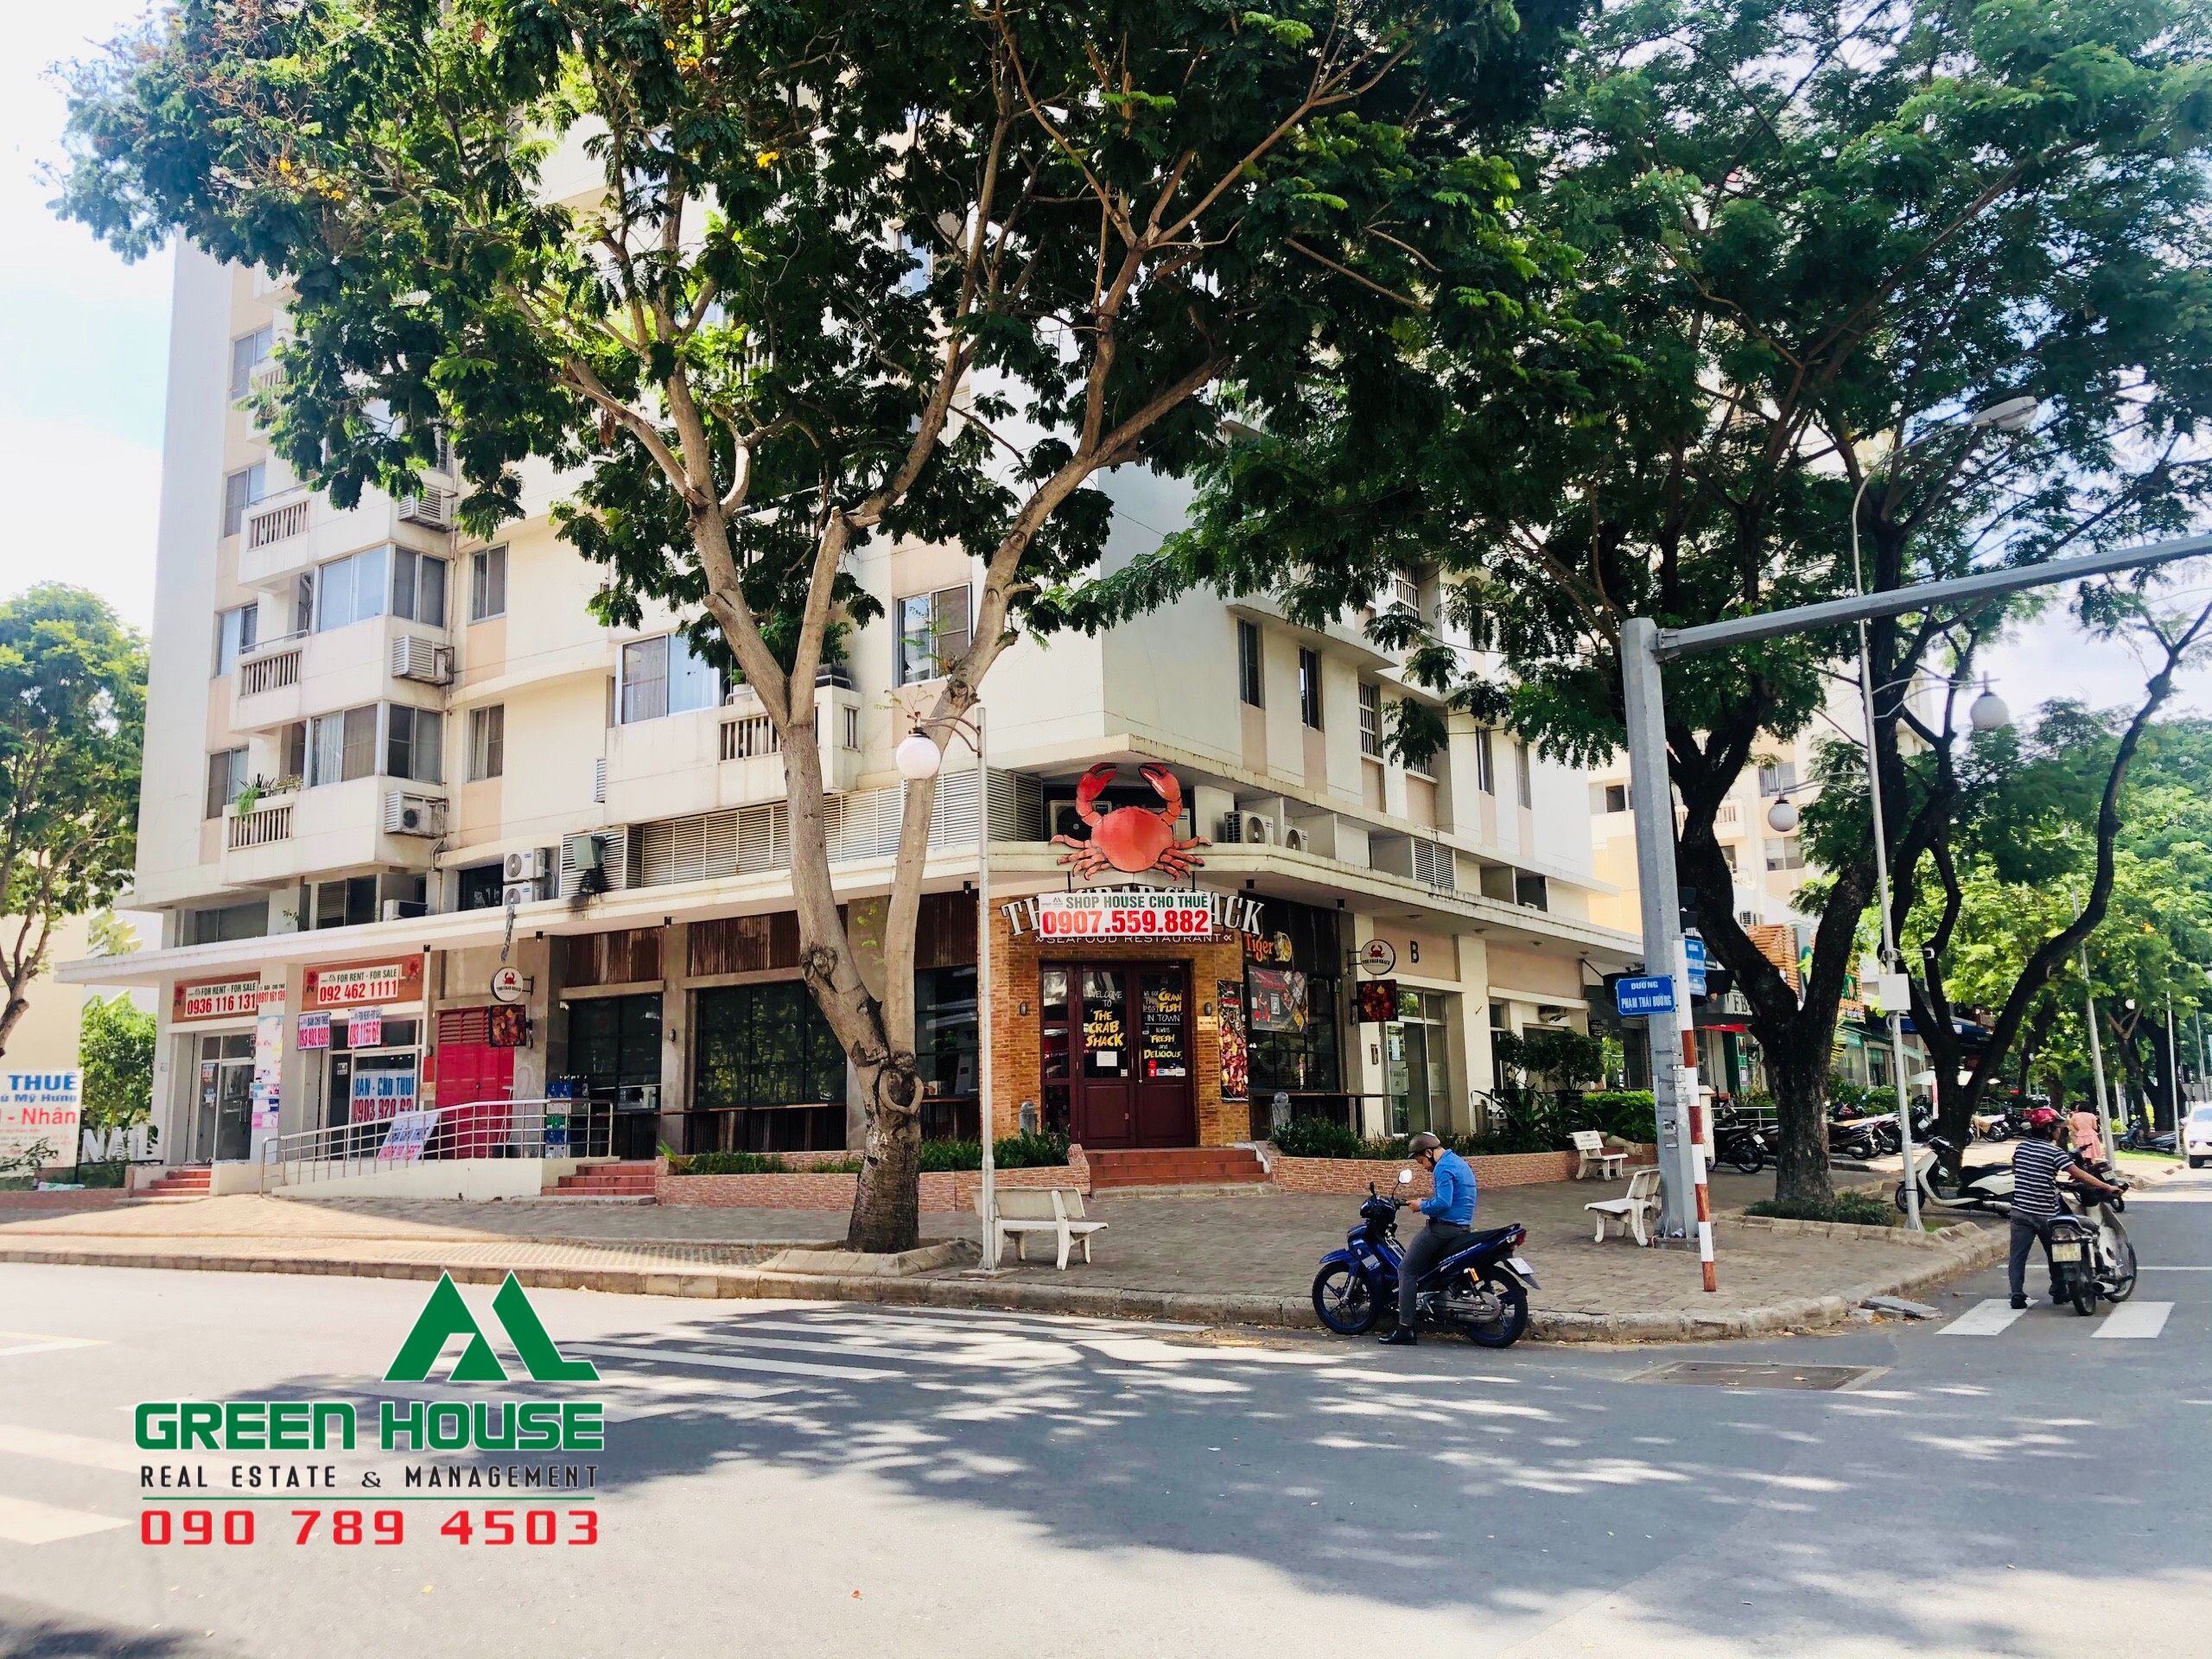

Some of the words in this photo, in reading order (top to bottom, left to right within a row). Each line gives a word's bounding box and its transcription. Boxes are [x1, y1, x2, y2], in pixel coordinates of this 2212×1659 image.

[1066, 896, 1099, 909] SHOP
[1104, 895, 1145, 908] HOUSE
[1149, 895, 1173, 908] CHO
[1178, 893, 1208, 907] THUÊ
[1001, 896, 1039, 936] TH
[1042, 910, 1209, 935] 0907.559.882
[1244, 933, 1274, 962] Tiger
[1410, 941, 1420, 963] B
[337, 974, 347, 982] FOR
[349, 972, 365, 982] RENT
[370, 970, 381, 980] FOR
[383, 969, 397, 978] SALE
[201, 988, 211, 996] FOR
[213, 986, 226, 995] RENT
[231, 984, 242, 993] FOR
[243, 982, 256, 991] SALE
[320, 985, 340, 1001] 092
[345, 983, 365, 1000] 462
[371, 980, 397, 996] 1111
[188, 998, 212, 1014] 0936
[216, 995, 233, 1012] 116
[238, 993, 256, 1009] 131
[1160, 1001, 1181, 1012] FISH
[1621, 997, 1637, 1011] PHẠM
[1093, 1010, 1113, 1020] THE
[1088, 1020, 1120, 1034] CRAB
[1085, 1033, 1124, 1047] SHACK
[8, 1071, 79, 1091] THUÊ
[15, 1094, 35, 1103] Mỹ
[22, 1108, 76, 1125] Nhân
